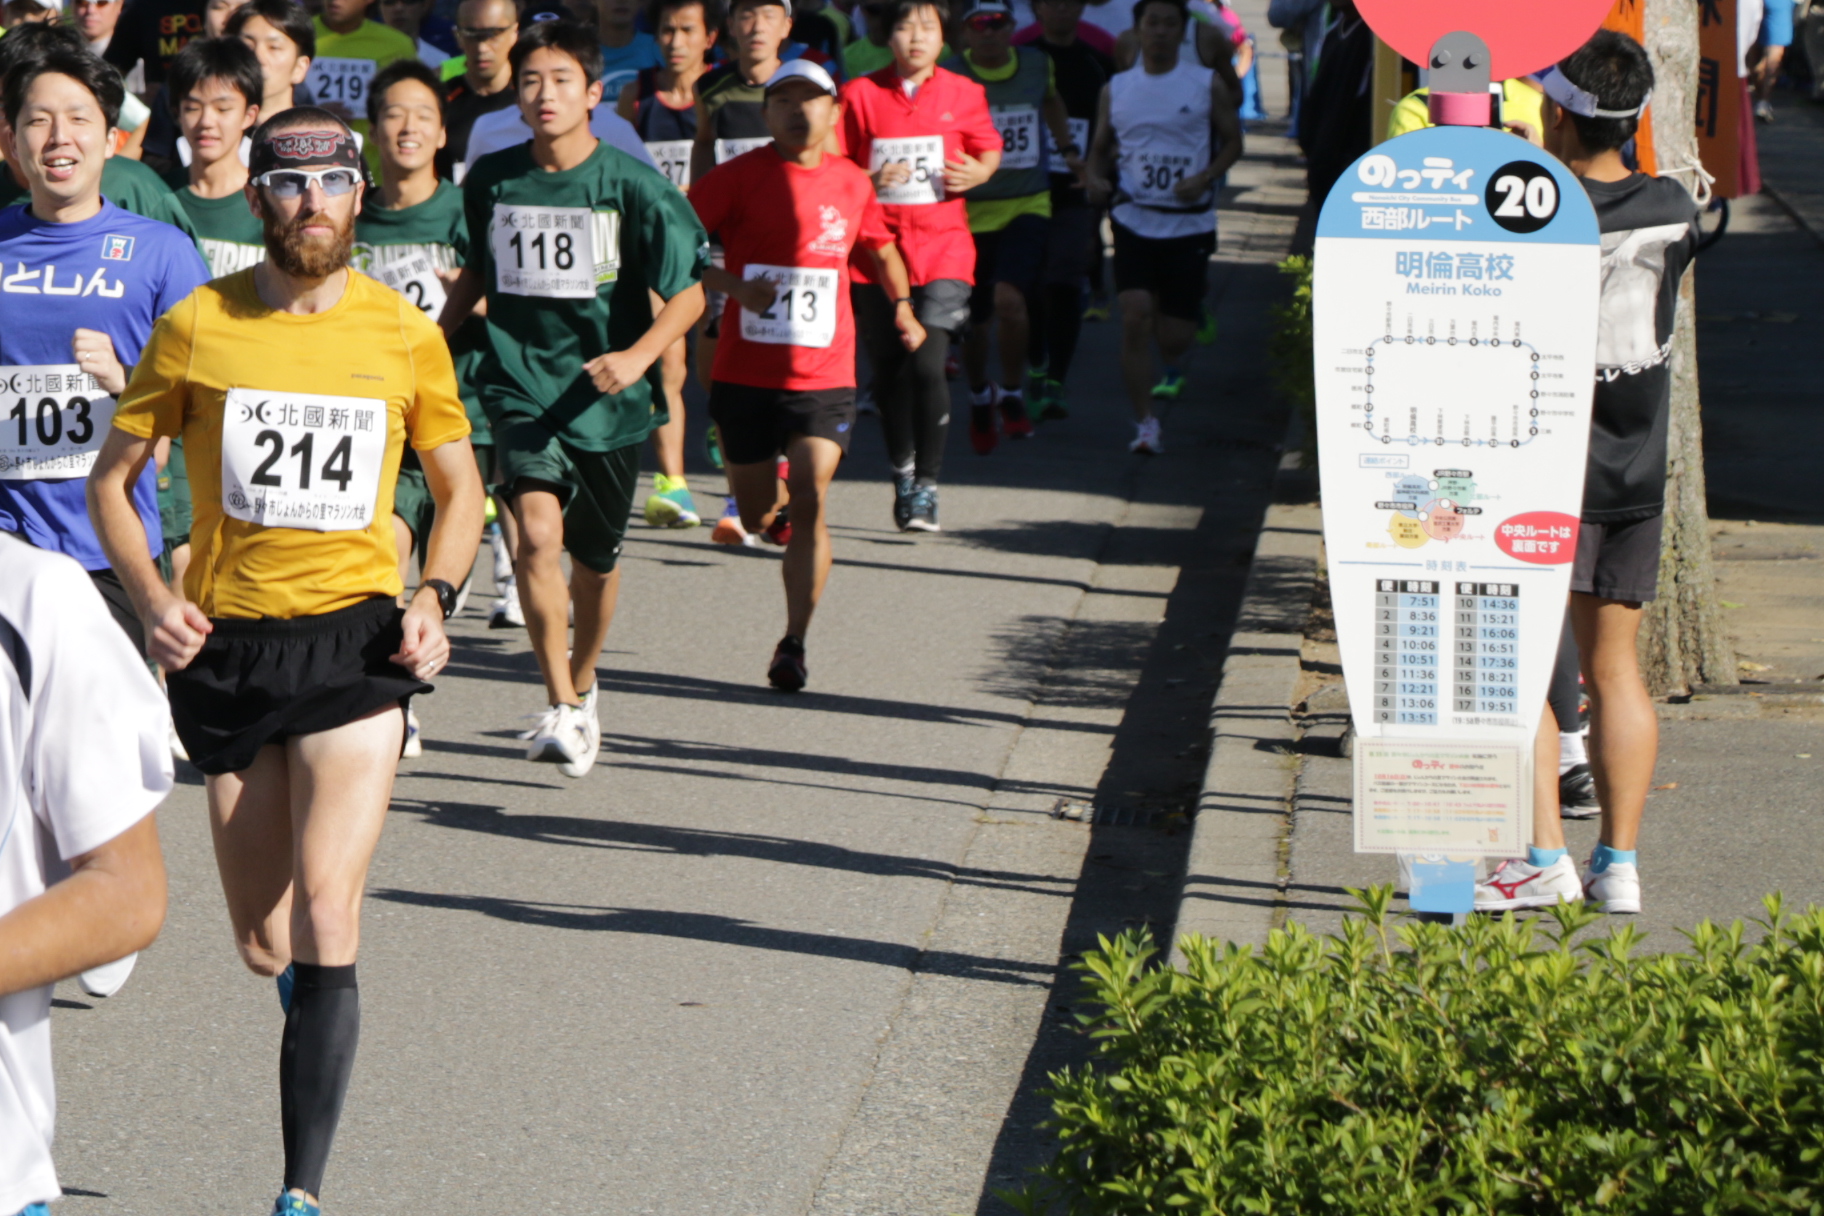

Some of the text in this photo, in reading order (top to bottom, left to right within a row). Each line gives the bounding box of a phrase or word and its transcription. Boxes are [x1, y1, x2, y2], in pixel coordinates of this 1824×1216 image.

[318, 75, 363, 100] 219
[1142, 164, 1184, 190] 301
[1358, 154, 1474, 189] のっティ
[1494, 175, 1556, 218] 20
[521, 213, 585, 230] 北國新聞
[1361, 206, 1473, 230] 西部ルート
[510, 231, 574, 270] 118
[1395, 251, 1514, 281] 明倫高校
[1406, 282, 1502, 298] Meirin Koko
[26, 373, 106, 393] 北國新聞
[10, 396, 94, 446] 103
[277, 403, 375, 431] 北國新聞
[250, 429, 354, 492] 214
[1501, 524, 1571, 538] 中央ルートは
[1511, 539, 1560, 553] 裏面です
[1426, 559, 1467, 572] 時刻表
[1407, 581, 1432, 593] 時刻
[1486, 584, 1512, 596] 時刻
[1384, 596, 1434, 606] 1 7:51
[1461, 599, 1515, 609] 10 14:36
[1384, 610, 1435, 621] 2 8:36
[1461, 613, 1514, 624] 11 15:21
[1383, 625, 1434, 635] 3 9:21
[1460, 628, 1515, 639] 12 16:06
[1383, 640, 1435, 650] 4 10:06
[1460, 643, 1514, 653] 13 16:51
[1383, 654, 1434, 665] 5 10:51
[1460, 657, 1515, 668] 14 17:36
[1382, 669, 1434, 679] 6 11:36
[1459, 672, 1513, 682] 15 18:21
[1382, 683, 1433, 694] 7 12:21
[1459, 686, 1514, 697] 16 19:06
[1382, 698, 1434, 708] 8 13:06
[1459, 701, 1513, 712] 17 19:51
[1382, 712, 1433, 723] 9 13:51
